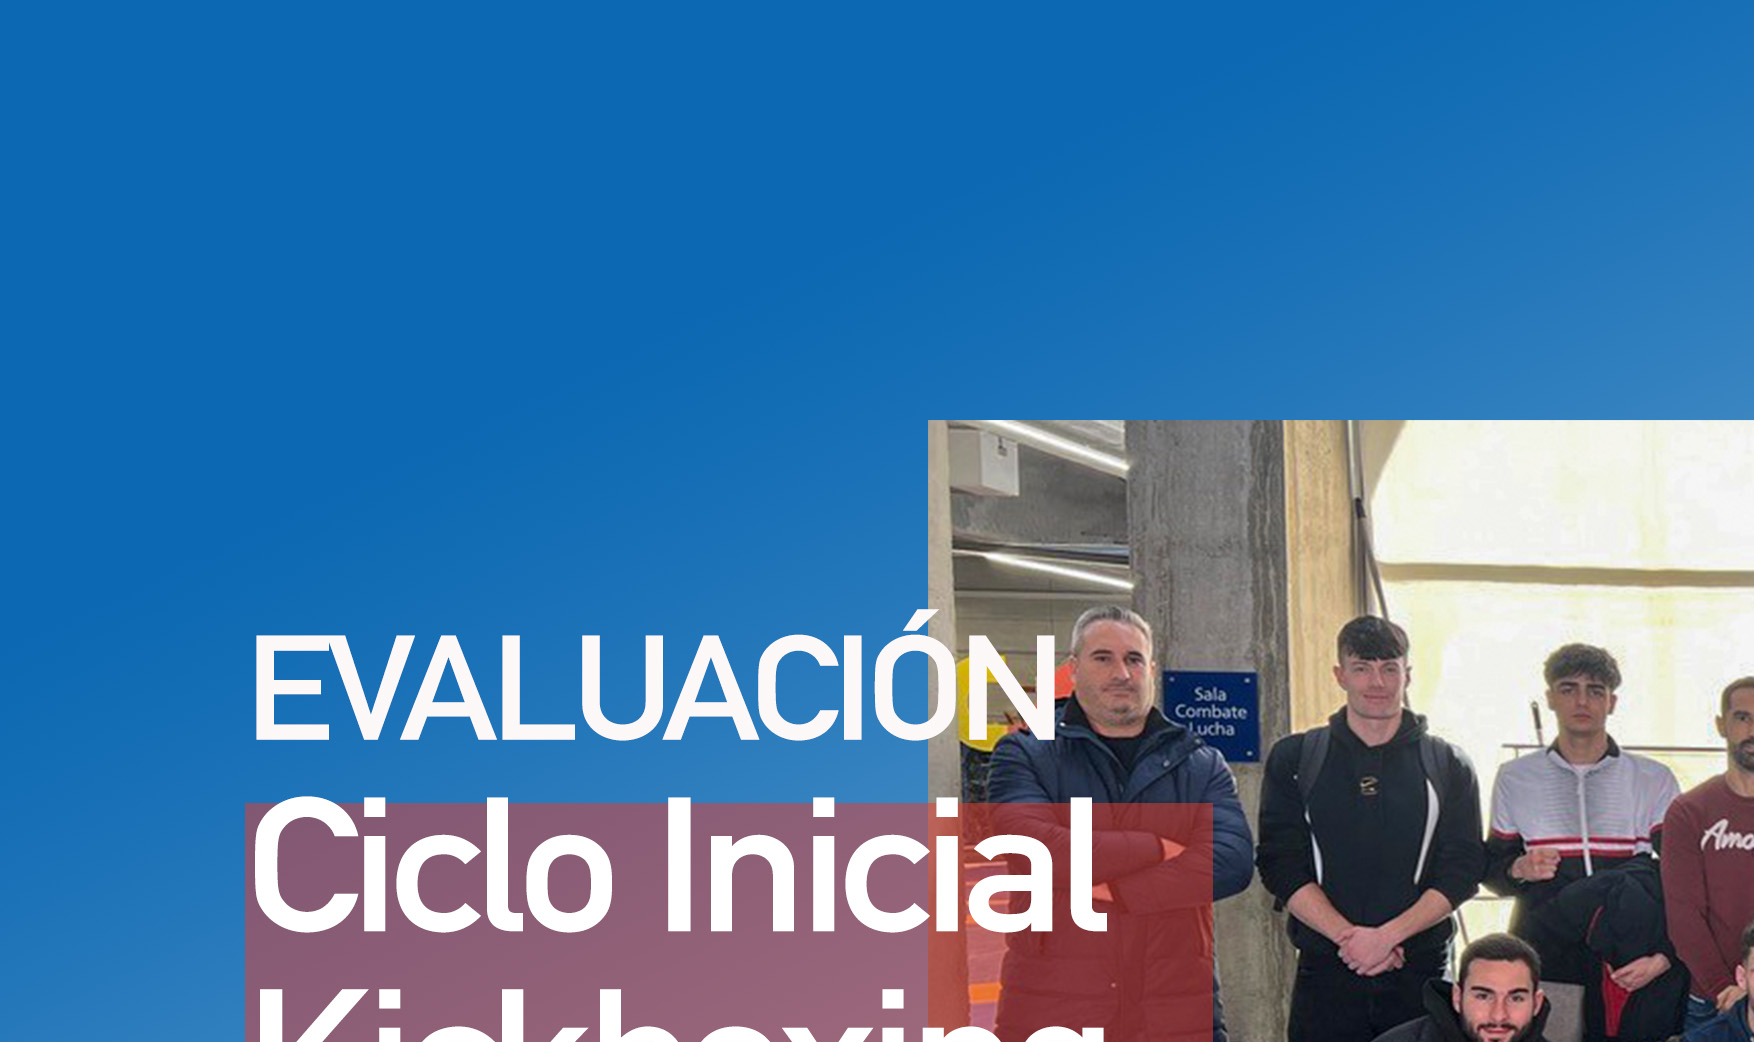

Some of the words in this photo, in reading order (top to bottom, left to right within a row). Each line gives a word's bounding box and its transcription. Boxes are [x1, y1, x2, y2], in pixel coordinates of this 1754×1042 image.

[1194, 686, 1228, 702] Sala
[1175, 703, 1248, 720] Combate
[1189, 721, 1235, 736] Lucha
